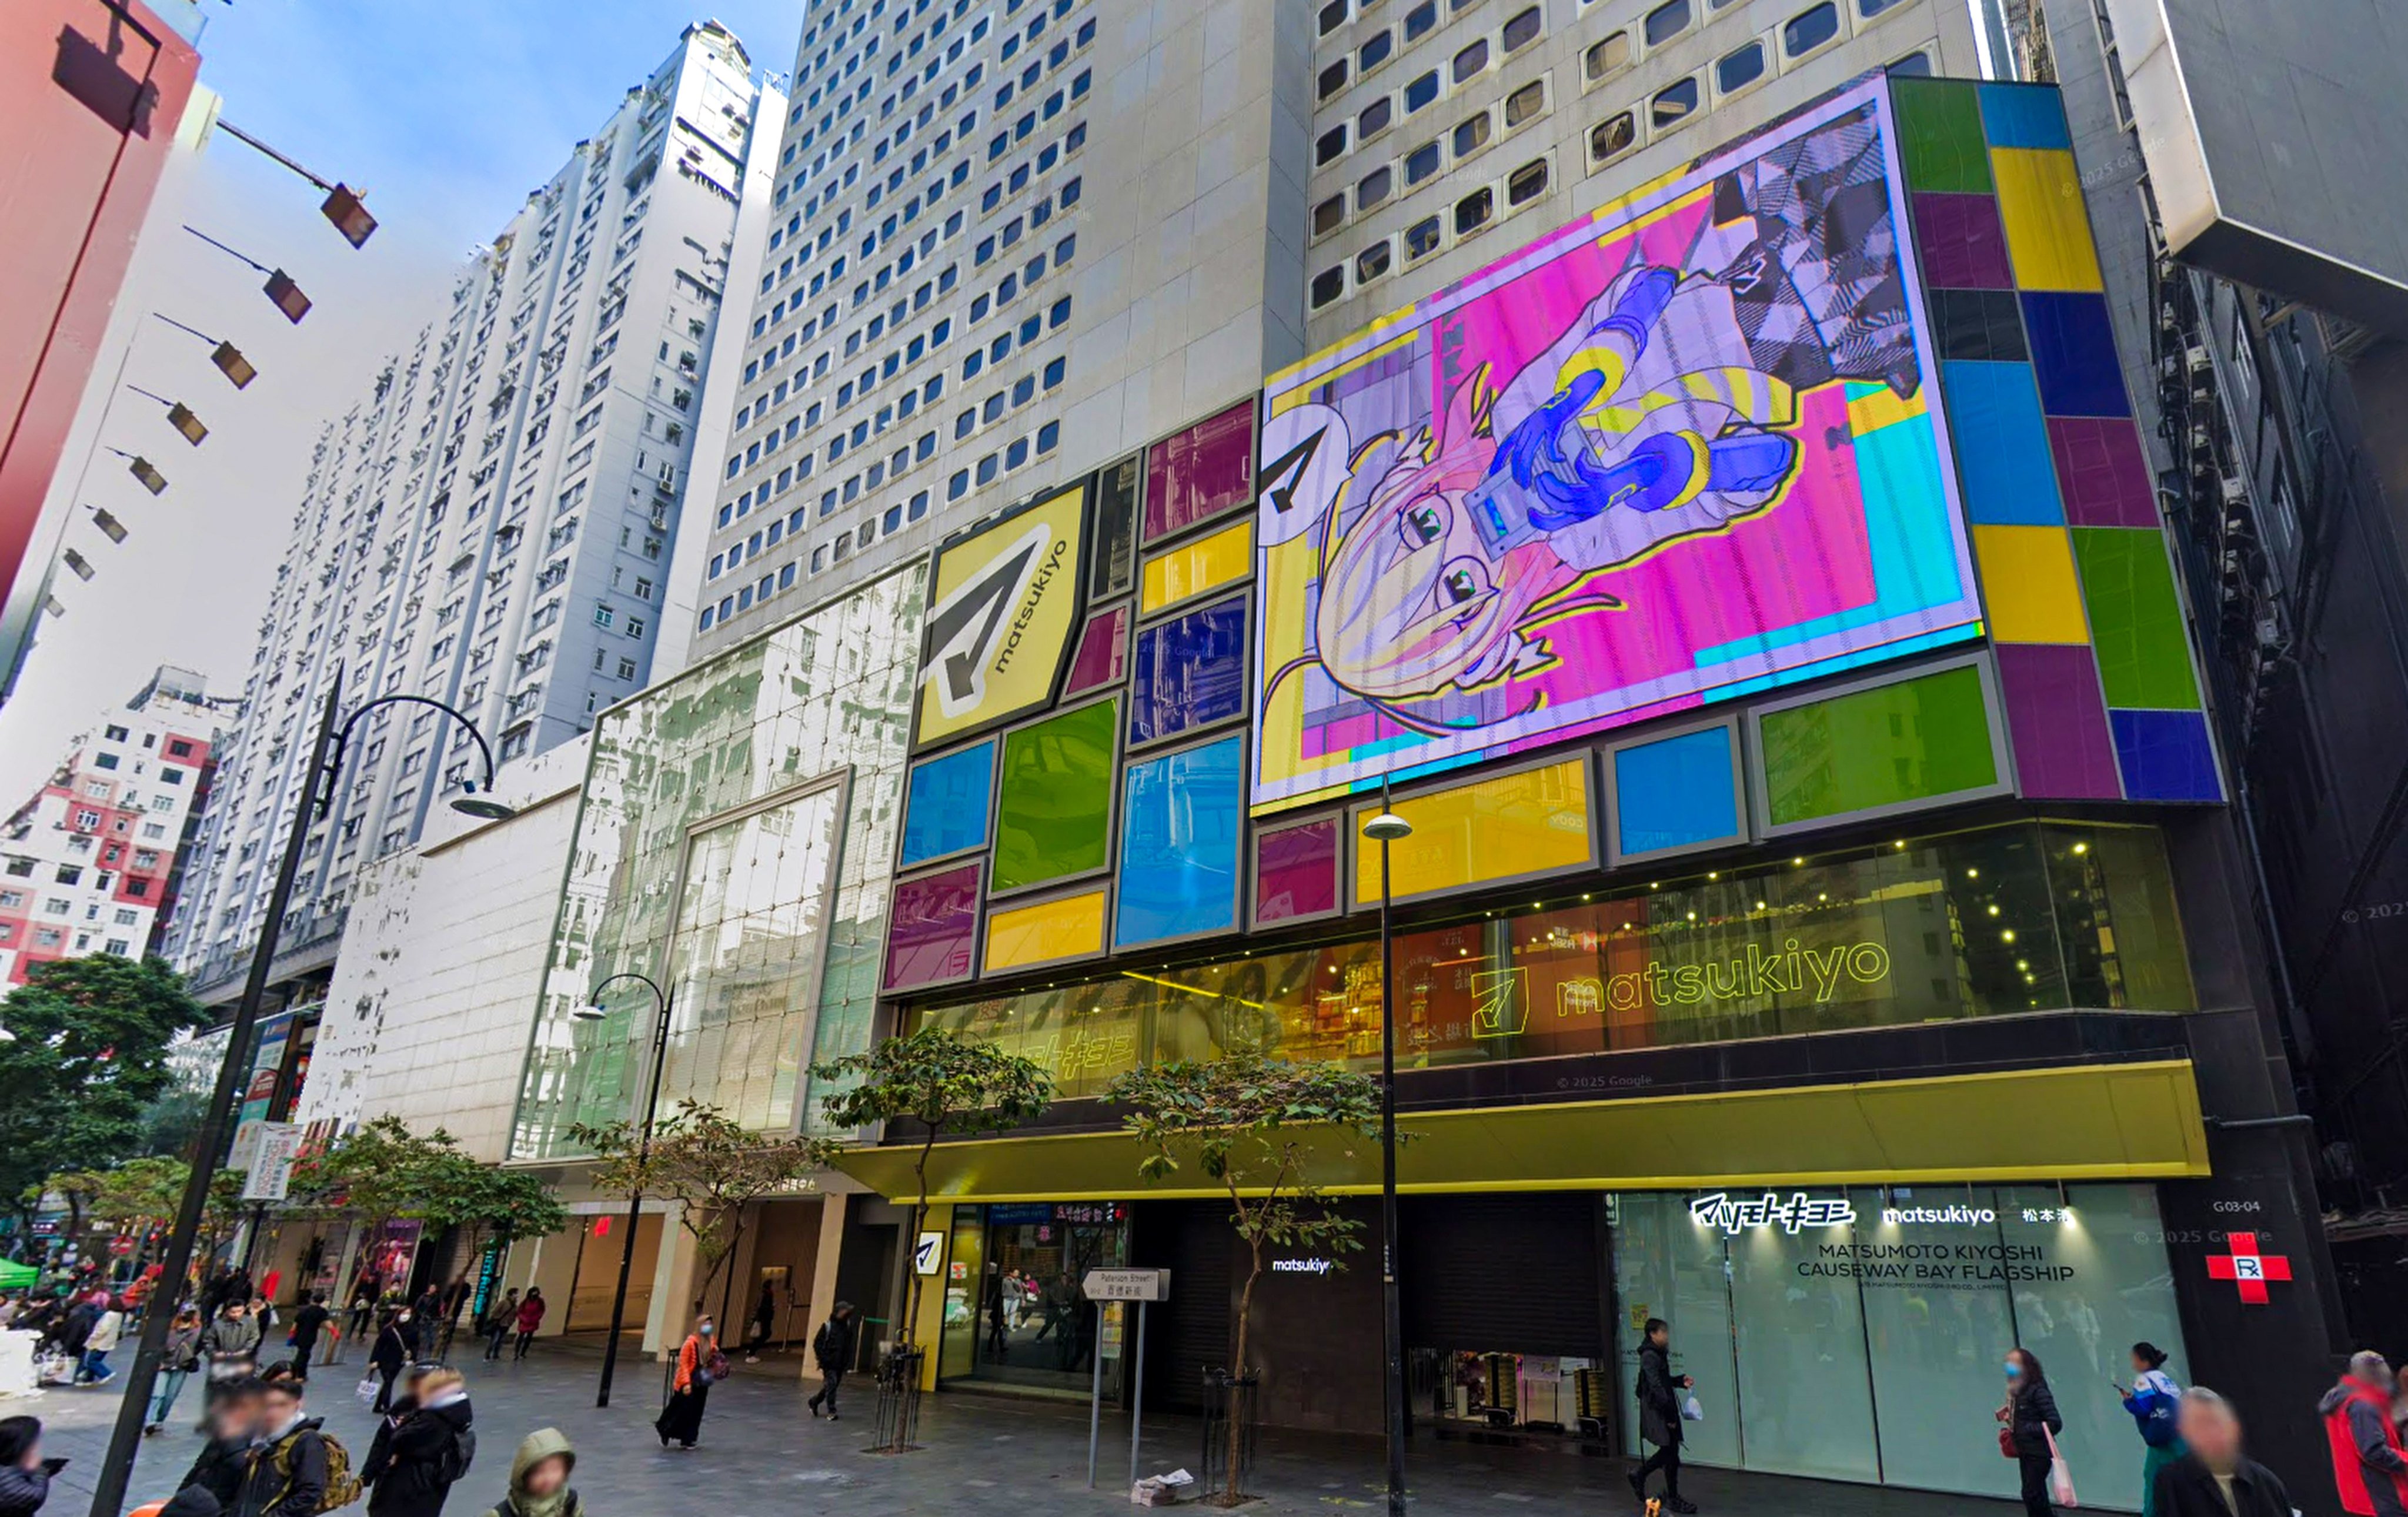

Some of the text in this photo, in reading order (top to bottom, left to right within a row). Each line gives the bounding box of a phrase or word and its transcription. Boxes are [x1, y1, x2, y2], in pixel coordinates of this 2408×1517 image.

[996, 539, 1067, 676] matsukiyo
[1557, 938, 1889, 1017] matsukiyo
[1692, 1194, 1855, 1234] マツモトキヨシ
[1882, 1205, 1995, 1227] matsukiyo
[1819, 1244, 2043, 1260] MATSUMOTO KIYOSHI
[1273, 1257, 1333, 1275] matsukiy
[1798, 1262, 2075, 1281] CAUSEWAY BAY FLAGSHIP
[2236, 1258, 2260, 1276] Rx
